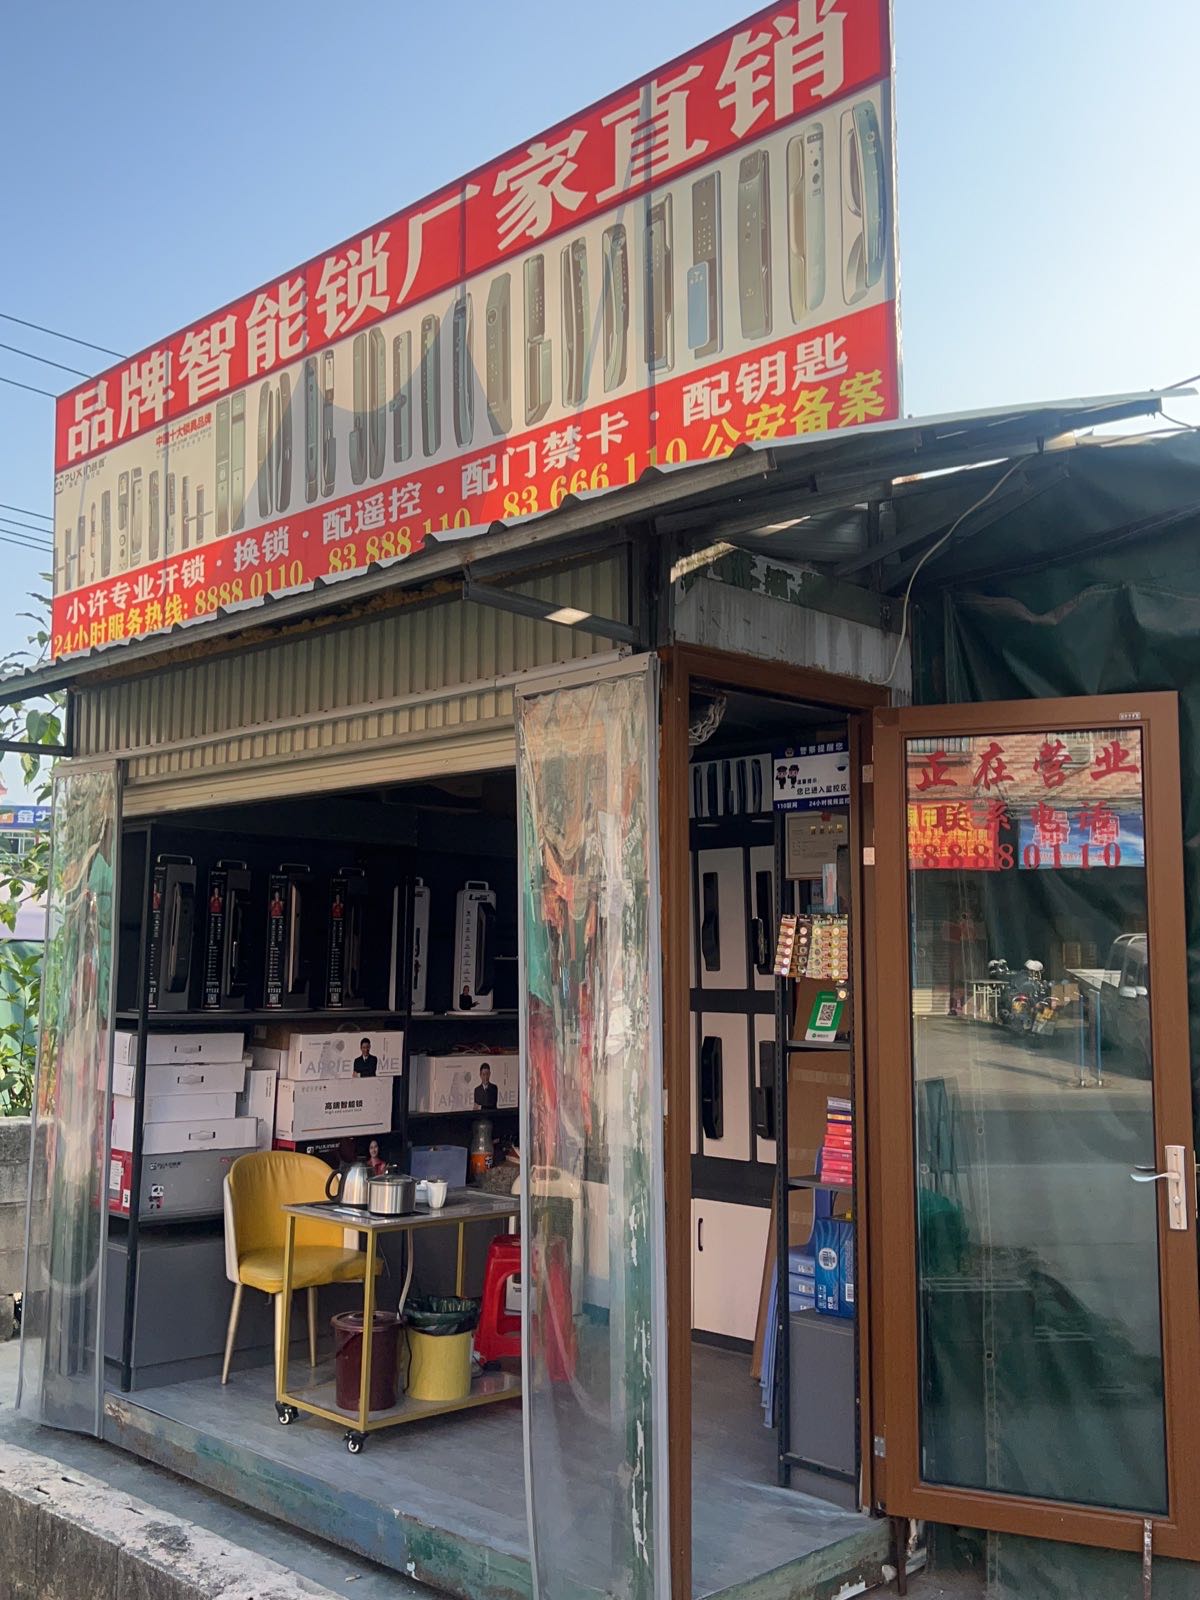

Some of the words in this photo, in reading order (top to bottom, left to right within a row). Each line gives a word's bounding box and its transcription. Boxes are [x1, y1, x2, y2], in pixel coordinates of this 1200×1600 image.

[66, 0, 848, 462] 品牌智能锁厂家直销
[66, 555, 206, 624] 小许专业开锁
[233, 527, 290, 572] 换锁
[322, 482, 423, 544] 配遥控
[461, 410, 629, 500] 配门禁卡
[683, 332, 849, 427] 配钥匙
[195, 578, 244, 615] 8888
[329, 548, 357, 574] 83
[365, 526, 412, 562] 888
[502, 485, 538, 519] 83
[702, 369, 885, 458] 公安备案
[915, 739, 1140, 792] 正在营业
